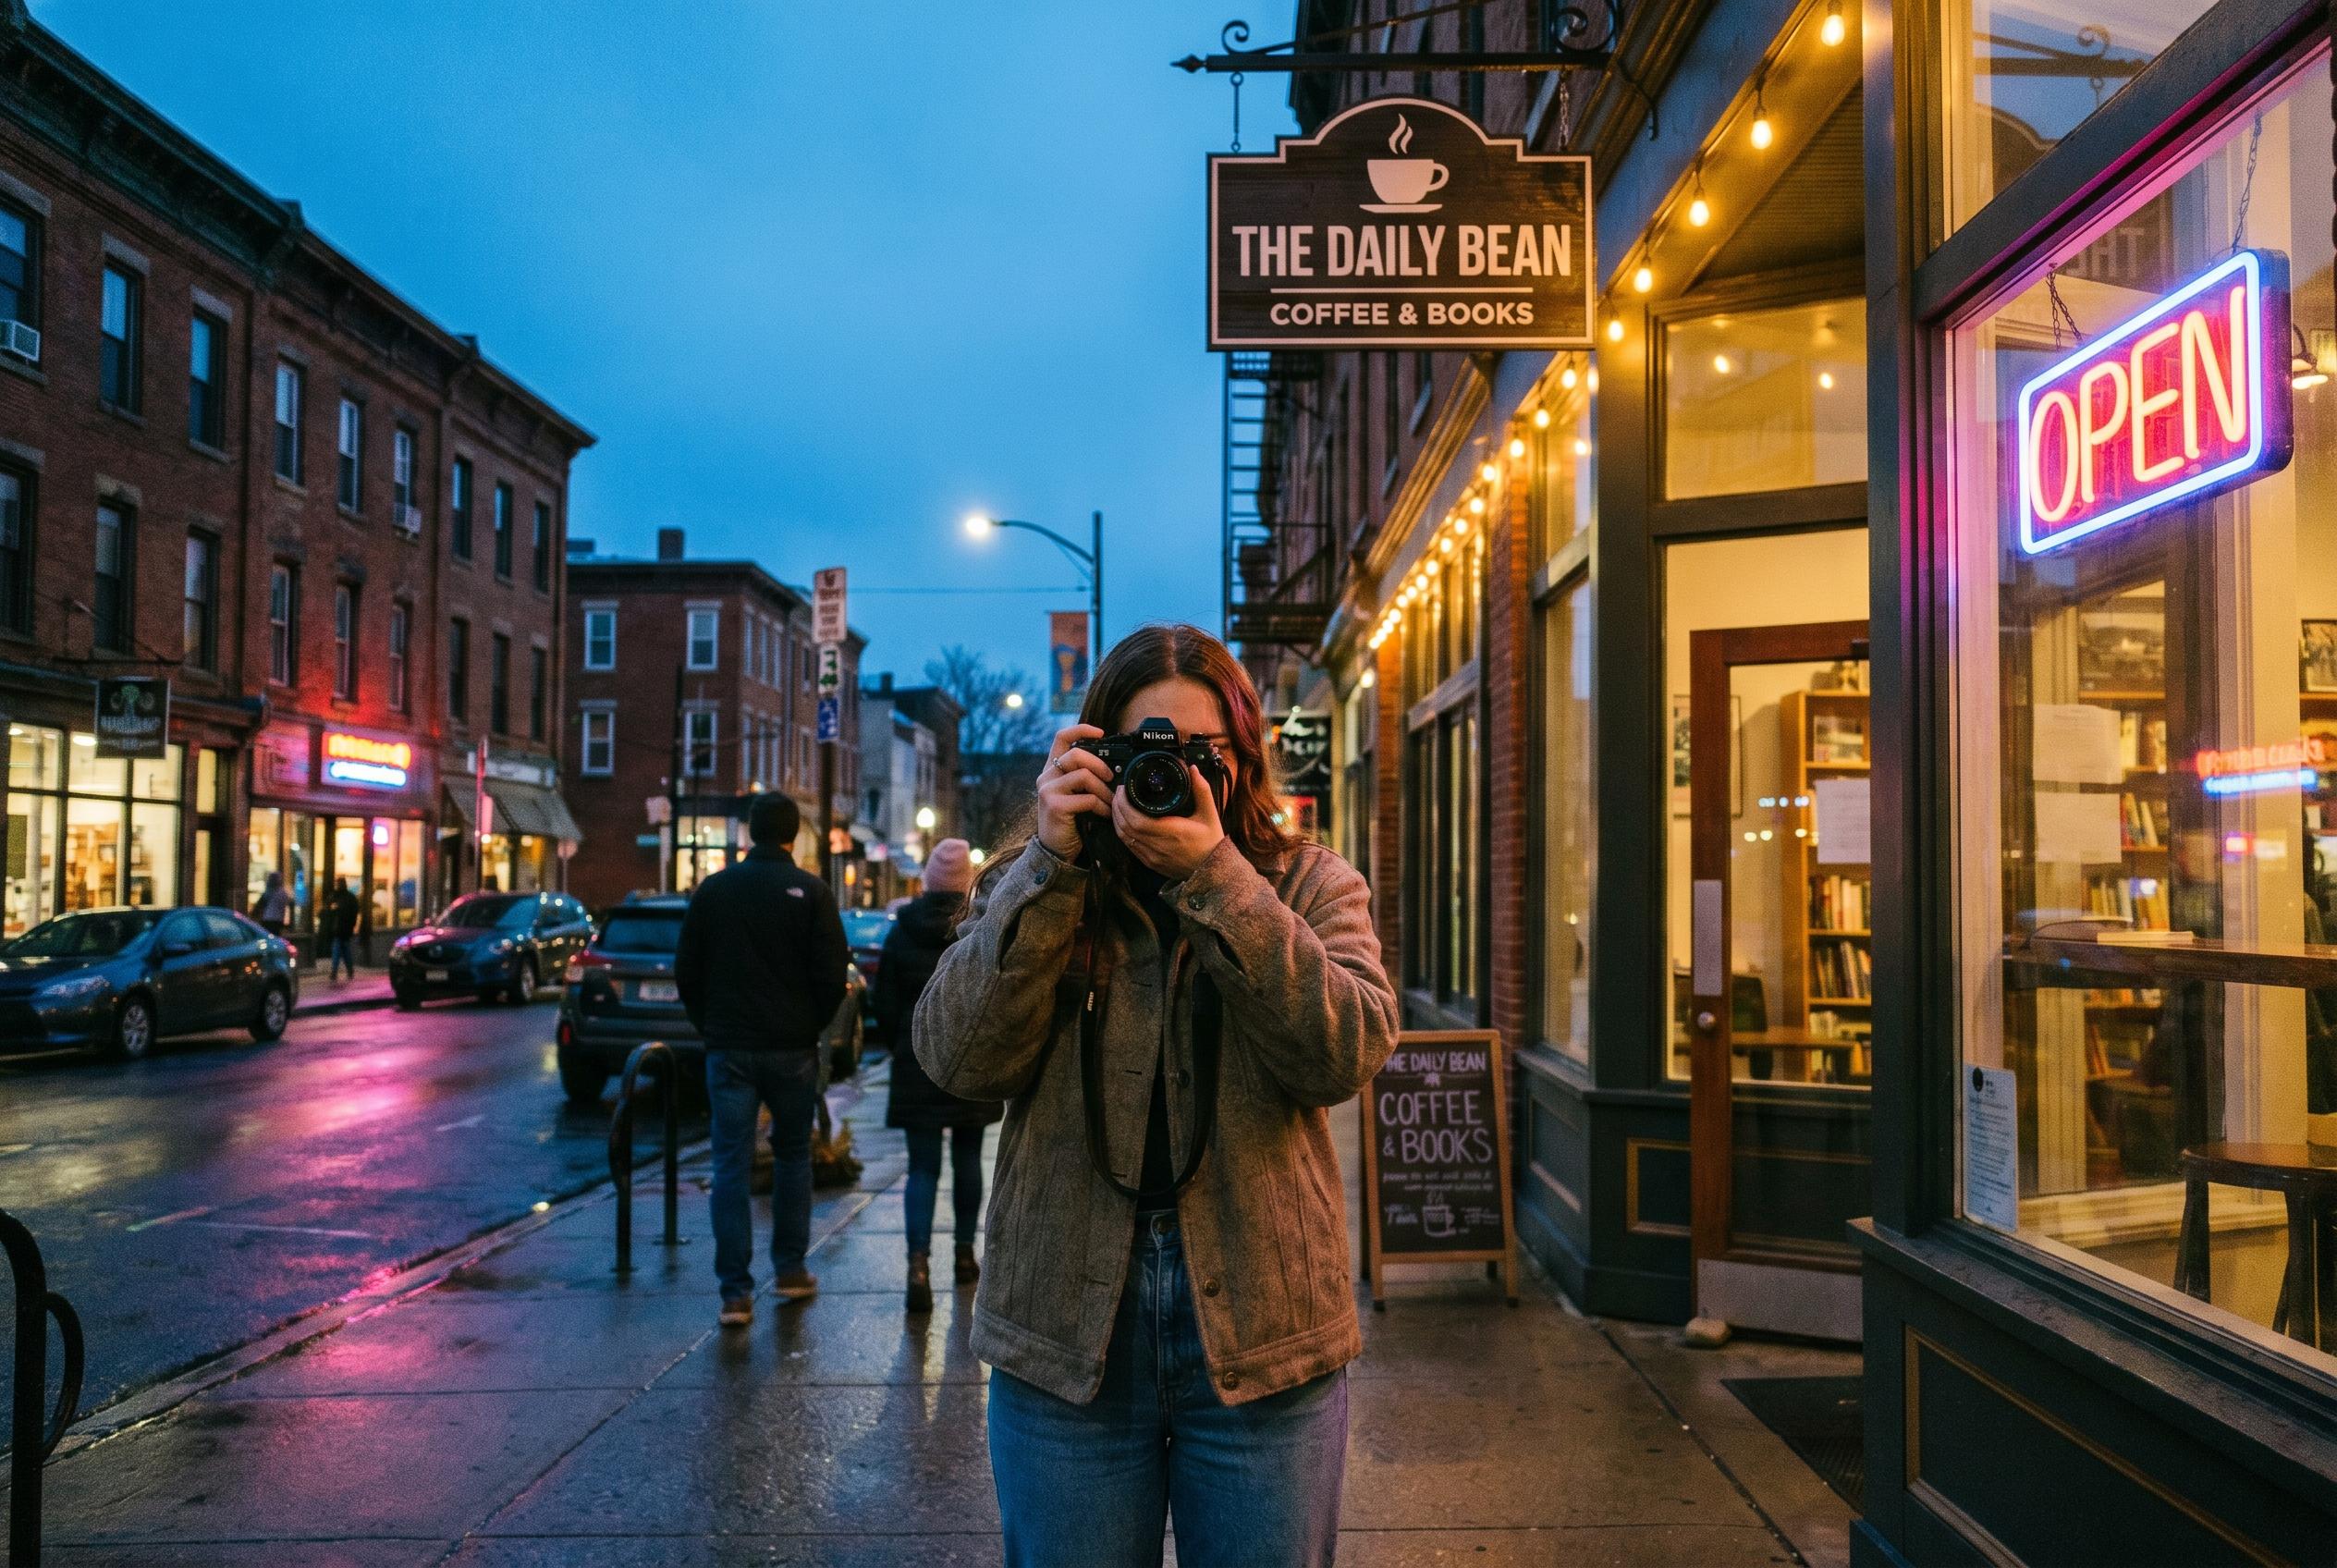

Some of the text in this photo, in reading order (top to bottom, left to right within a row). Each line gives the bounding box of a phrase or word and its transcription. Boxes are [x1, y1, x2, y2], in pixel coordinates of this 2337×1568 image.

[1232, 225, 1571, 276] THE DAILY BEAN
[1270, 302, 1534, 325] COFFEE & BOOKS
[2029, 286, 2246, 522] OPEN
[1143, 731, 1175, 740] Nikon
[1386, 1051, 1487, 1072] HE DAILY BEAN
[1379, 1090, 1483, 1126] COFFEE
[1382, 1128, 1493, 1164] & BOOKS
